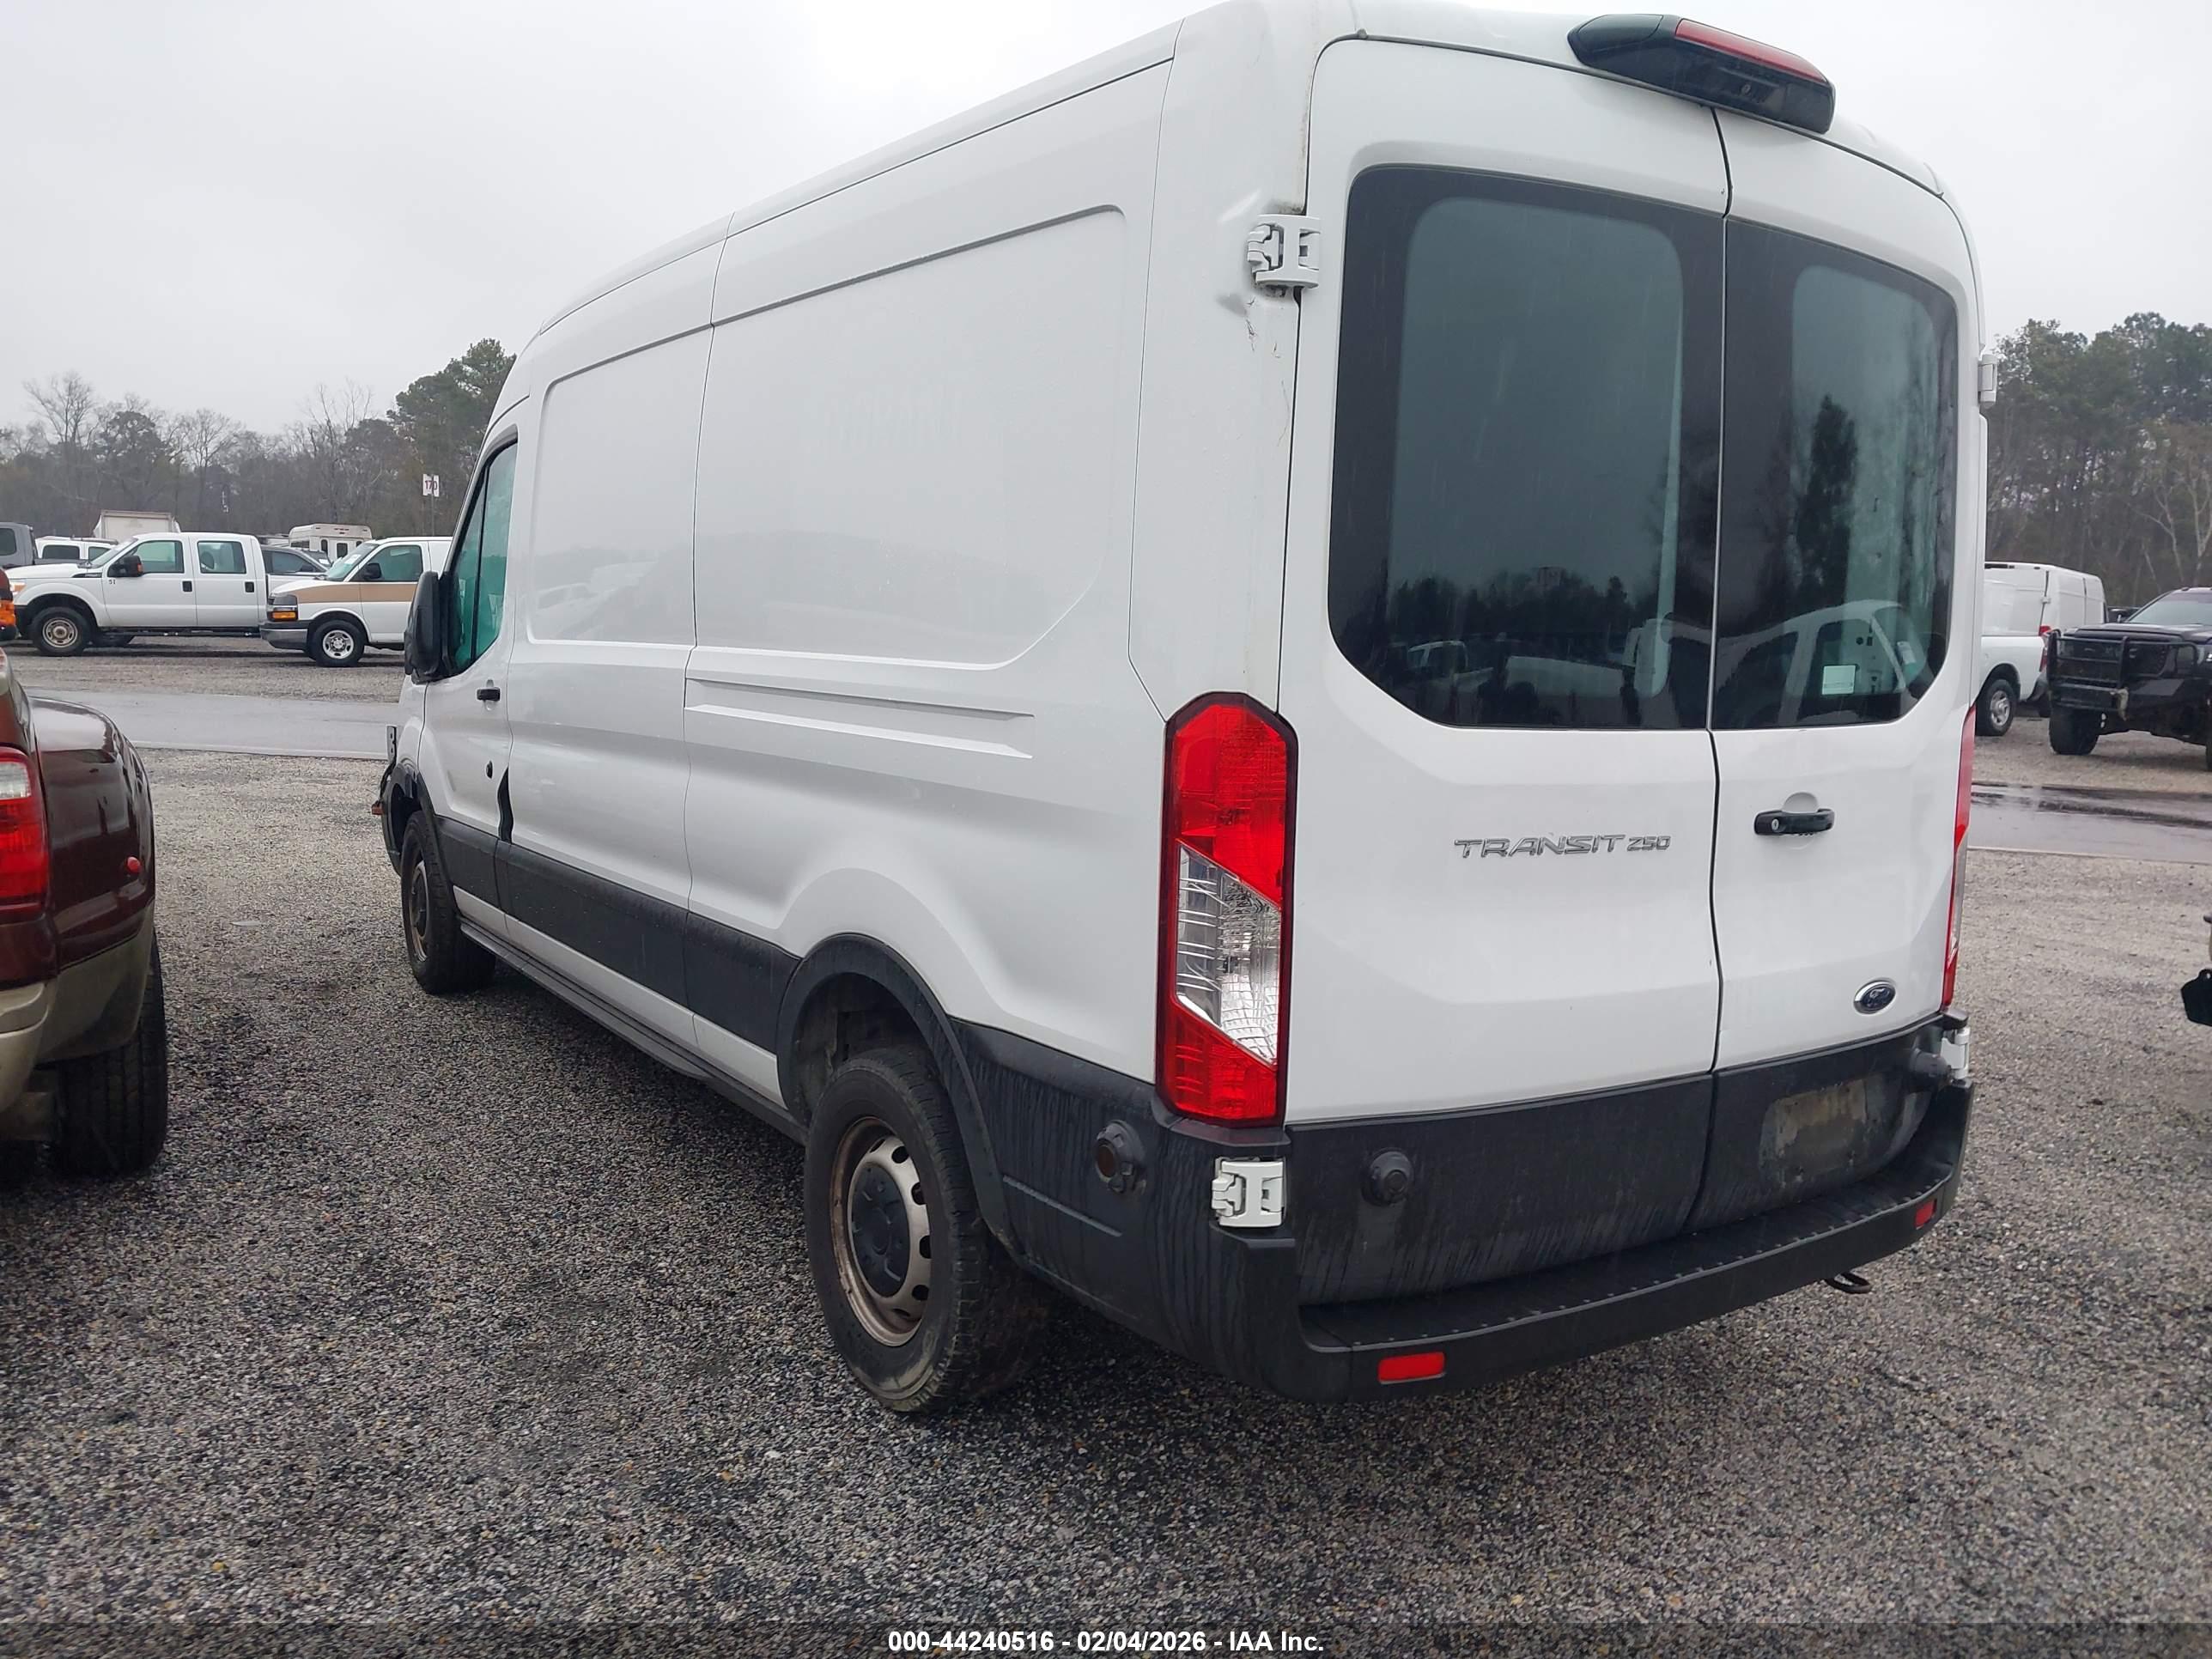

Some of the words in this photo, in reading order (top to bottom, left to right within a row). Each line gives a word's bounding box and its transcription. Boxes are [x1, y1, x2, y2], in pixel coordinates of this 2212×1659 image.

[424, 480, 438, 490] 170
[1454, 835, 1626, 859] TRANSIT
[1627, 836, 1672, 852] 250
